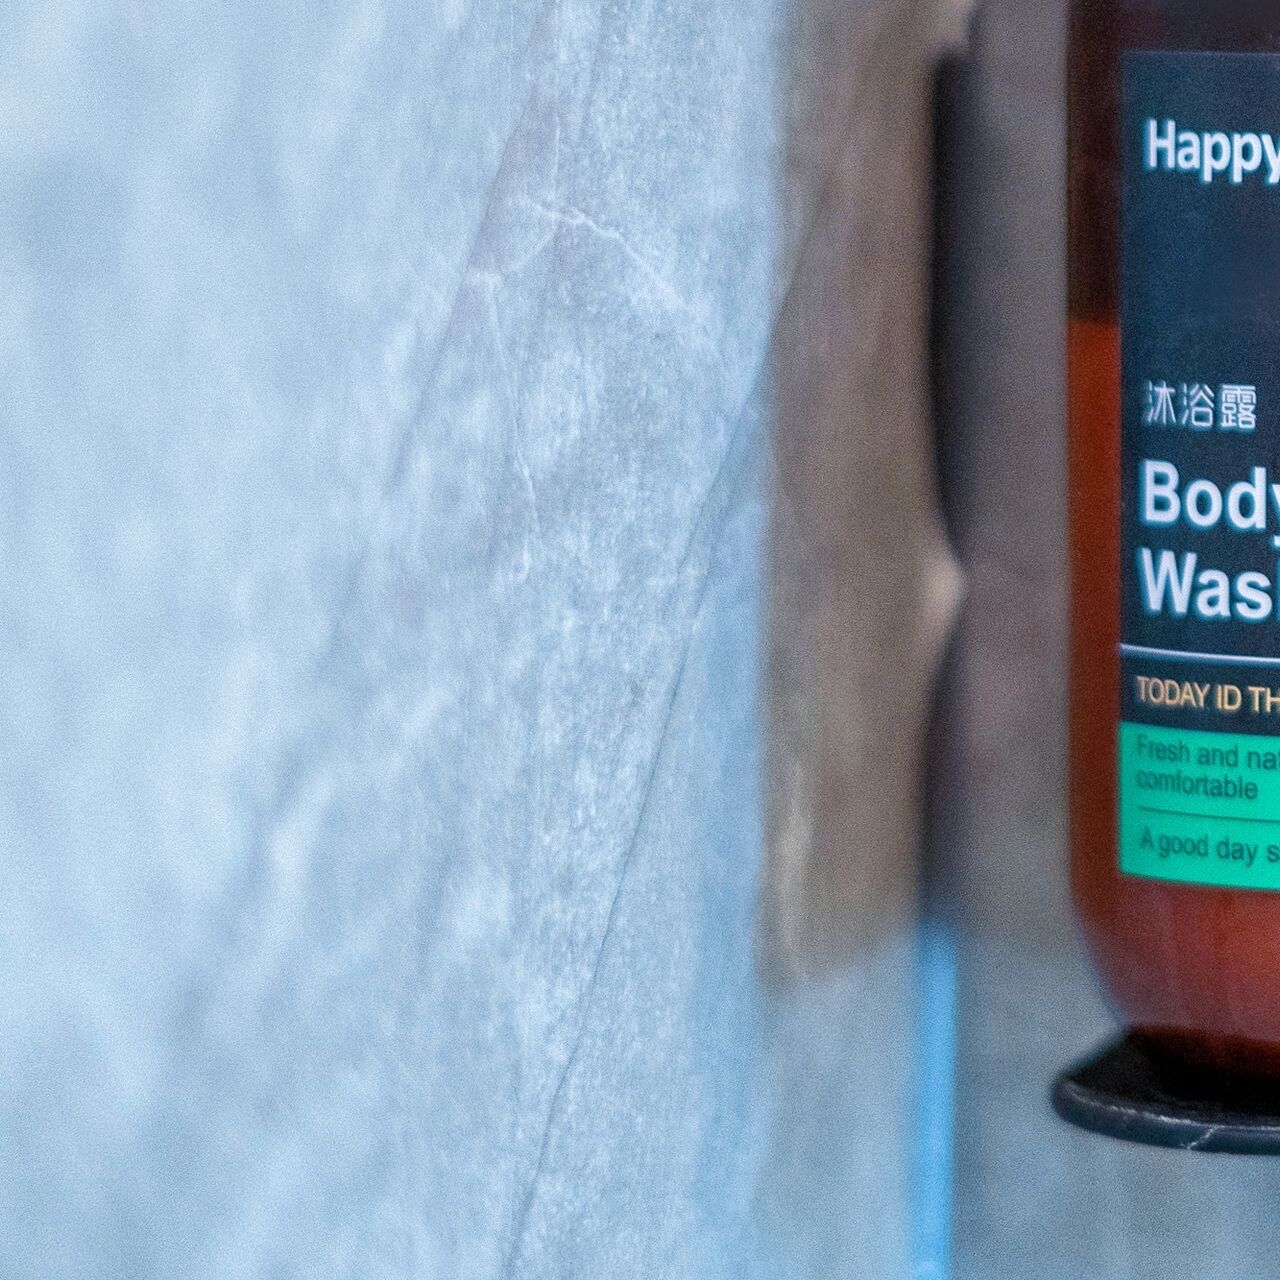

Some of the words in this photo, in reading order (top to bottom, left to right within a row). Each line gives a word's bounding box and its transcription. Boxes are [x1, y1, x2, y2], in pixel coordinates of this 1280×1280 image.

[1145, 380, 1257, 430] 沐浴露
[1136, 676, 1211, 709] TODAY
[1216, 684, 1242, 712] ID
[1137, 735, 1191, 764] Fresh
[1196, 744, 1239, 768] and
[1135, 770, 1259, 800] comfortable
[1139, 824, 1156, 851] A
[1157, 832, 1210, 861] good
[1216, 839, 1258, 869] day
